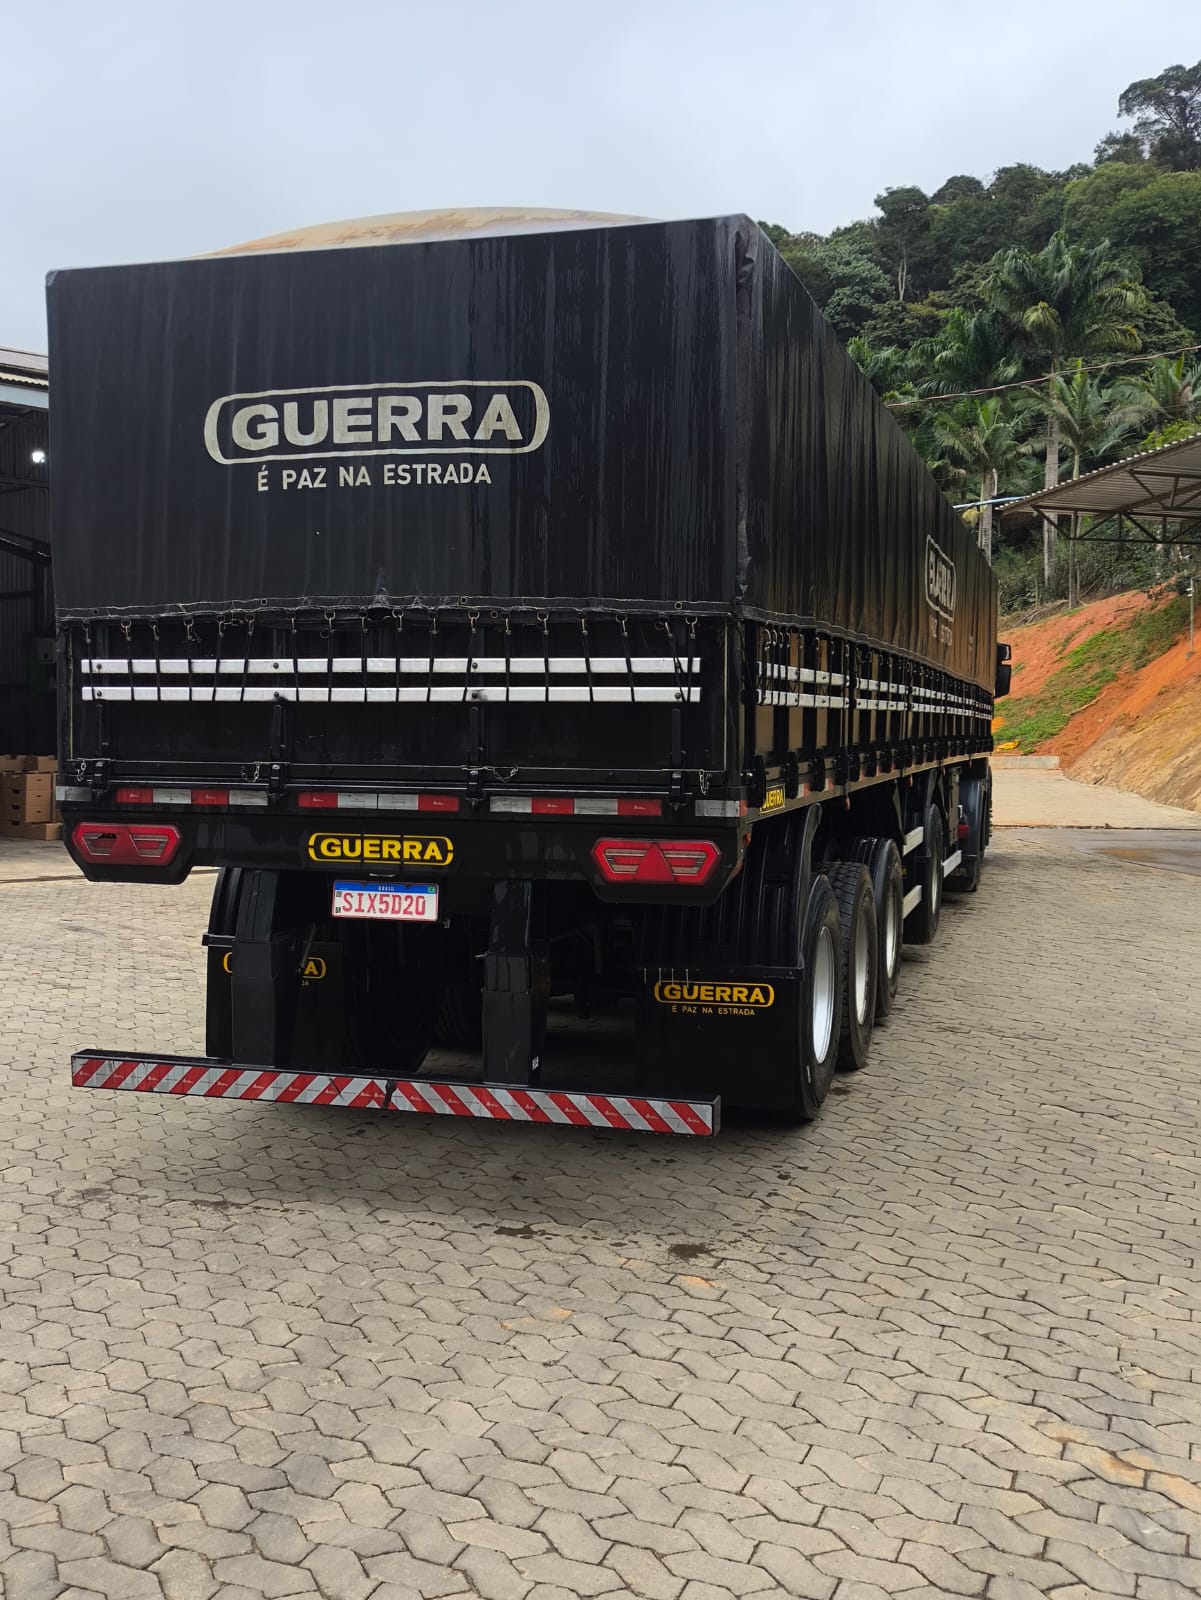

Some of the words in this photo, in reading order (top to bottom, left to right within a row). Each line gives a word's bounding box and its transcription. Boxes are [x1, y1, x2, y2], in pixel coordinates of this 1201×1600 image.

[231, 393, 523, 450] GUERRA
[257, 465, 269, 491] É
[282, 468, 327, 490] PAZ
[339, 465, 371, 487] NA
[383, 462, 492, 485] ESTRADA
[320, 838, 443, 860] GUERRA
[342, 892, 426, 916] SIX5D20
[663, 984, 765, 1003] GUERRA
[681, 1006, 697, 1014] PAZ
[702, 1007, 713, 1015] NA
[718, 1007, 755, 1016] ESTRADA
